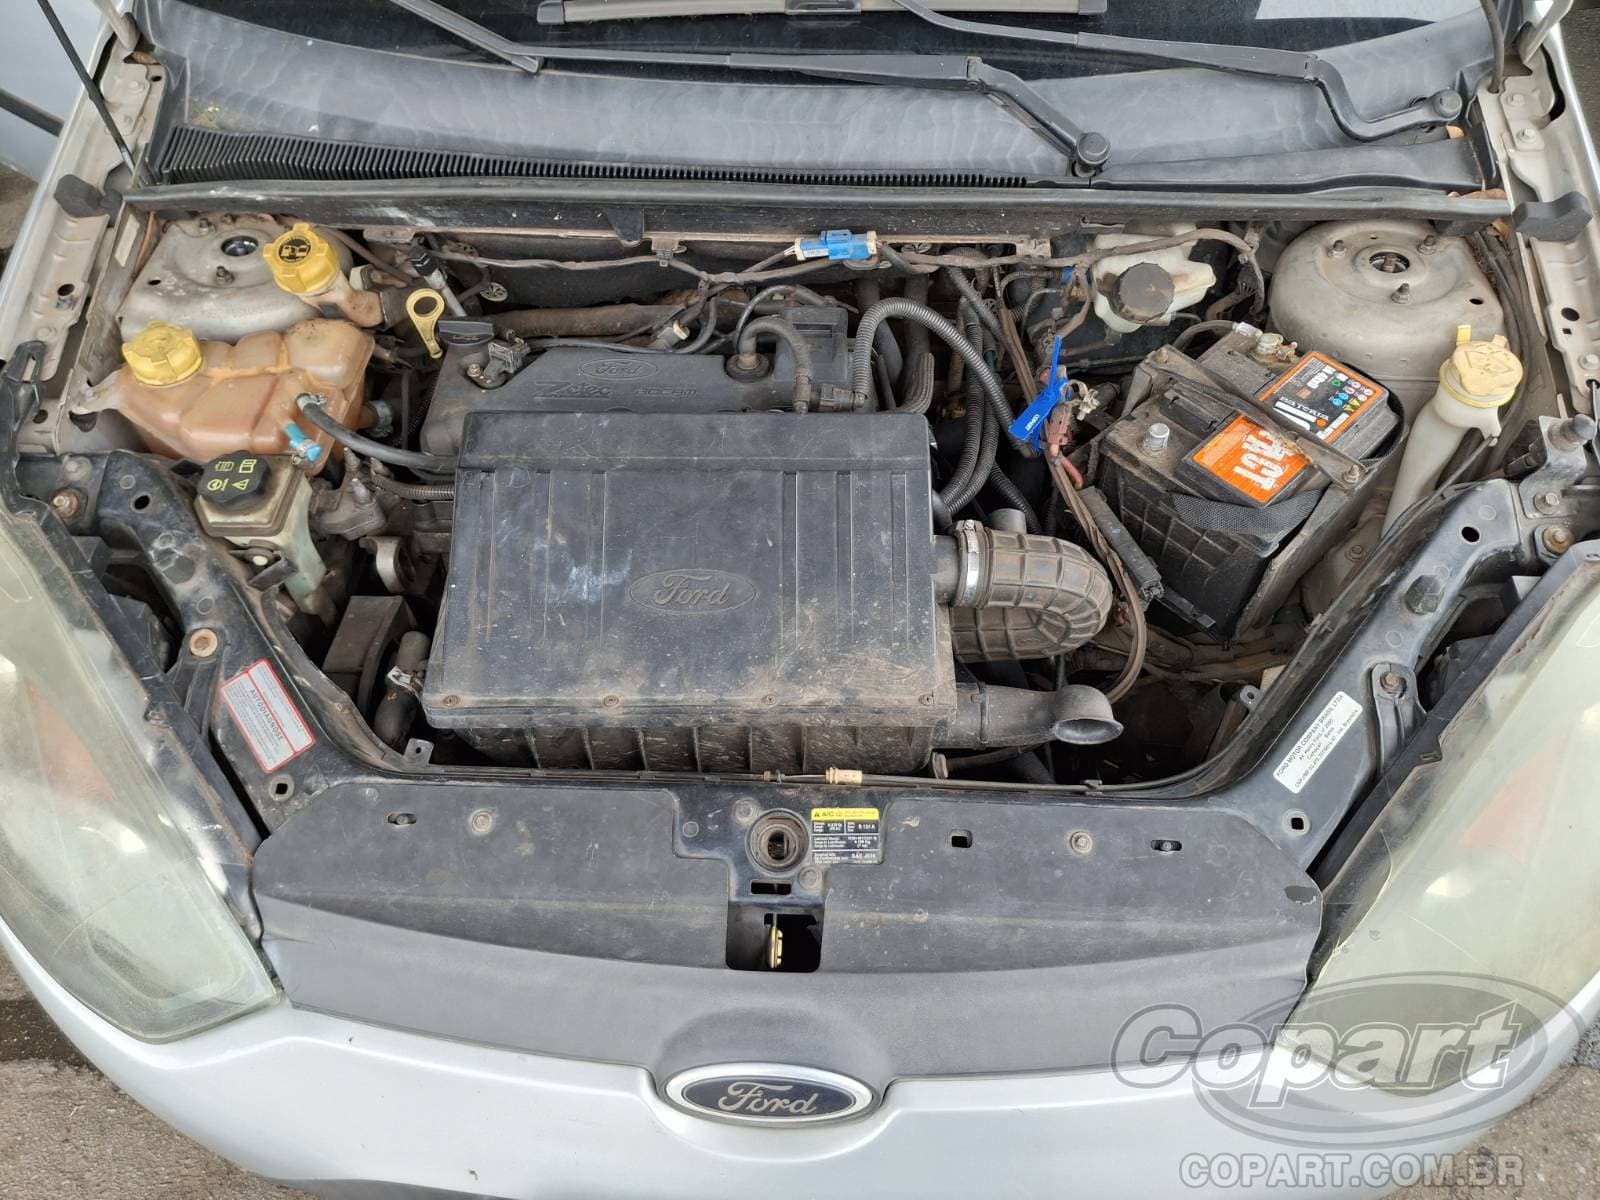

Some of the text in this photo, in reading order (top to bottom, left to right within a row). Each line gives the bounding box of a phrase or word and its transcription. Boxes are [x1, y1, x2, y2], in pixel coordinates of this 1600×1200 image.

[595, 360, 642, 375] Ford
[655, 574, 731, 605] Ford
[248, 688, 285, 742] AUTODIAGNOSE
[1286, 744, 1303, 764] MOTOR
[1300, 722, 1320, 746] COMPANY
[1318, 705, 1334, 724] BRASIL
[718, 1081, 819, 1114] Ford
